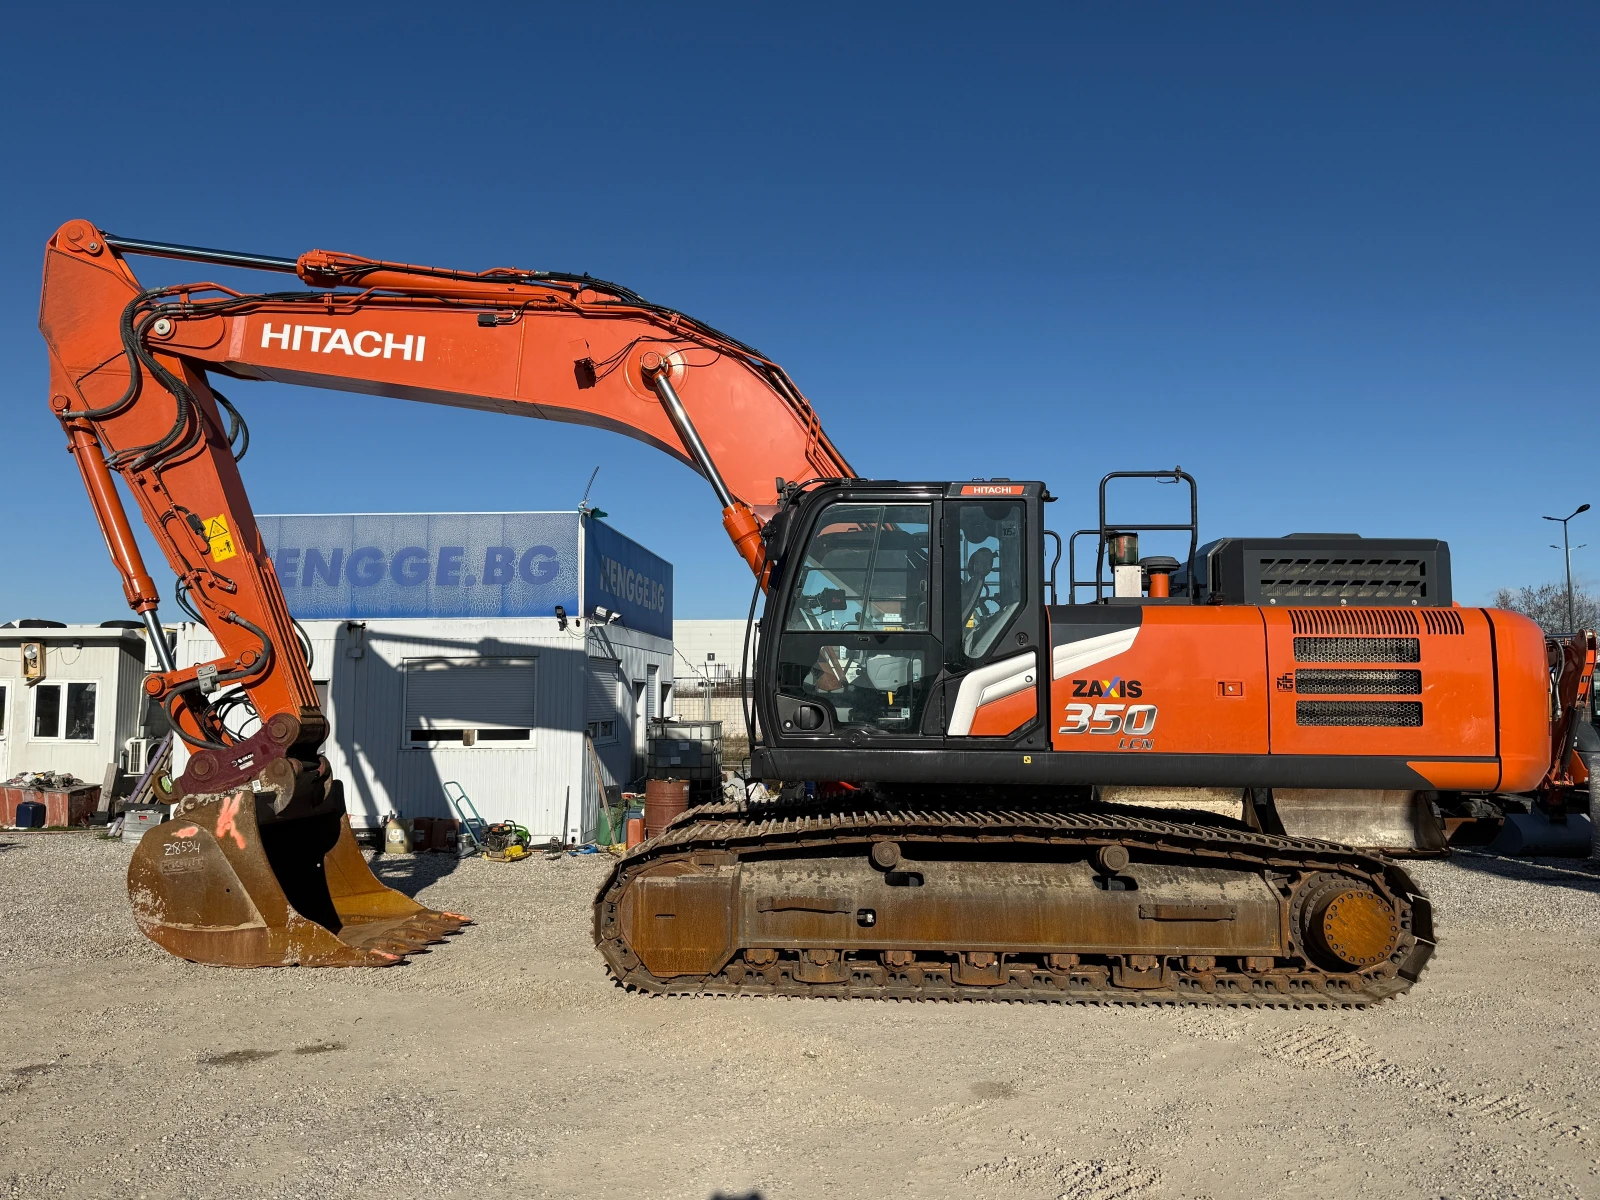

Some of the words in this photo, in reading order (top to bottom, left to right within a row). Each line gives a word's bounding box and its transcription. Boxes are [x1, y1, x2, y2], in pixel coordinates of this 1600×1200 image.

[261, 322, 426, 362] HITACHI
[973, 486, 1012, 494] HITACHI
[266, 545, 560, 588] ENGGE.BG
[600, 554, 665, 614] HENGGE.BG
[1072, 676, 1143, 698] ZAXIS
[1058, 703, 1158, 735] 350
[1118, 738, 1154, 750] LCN
